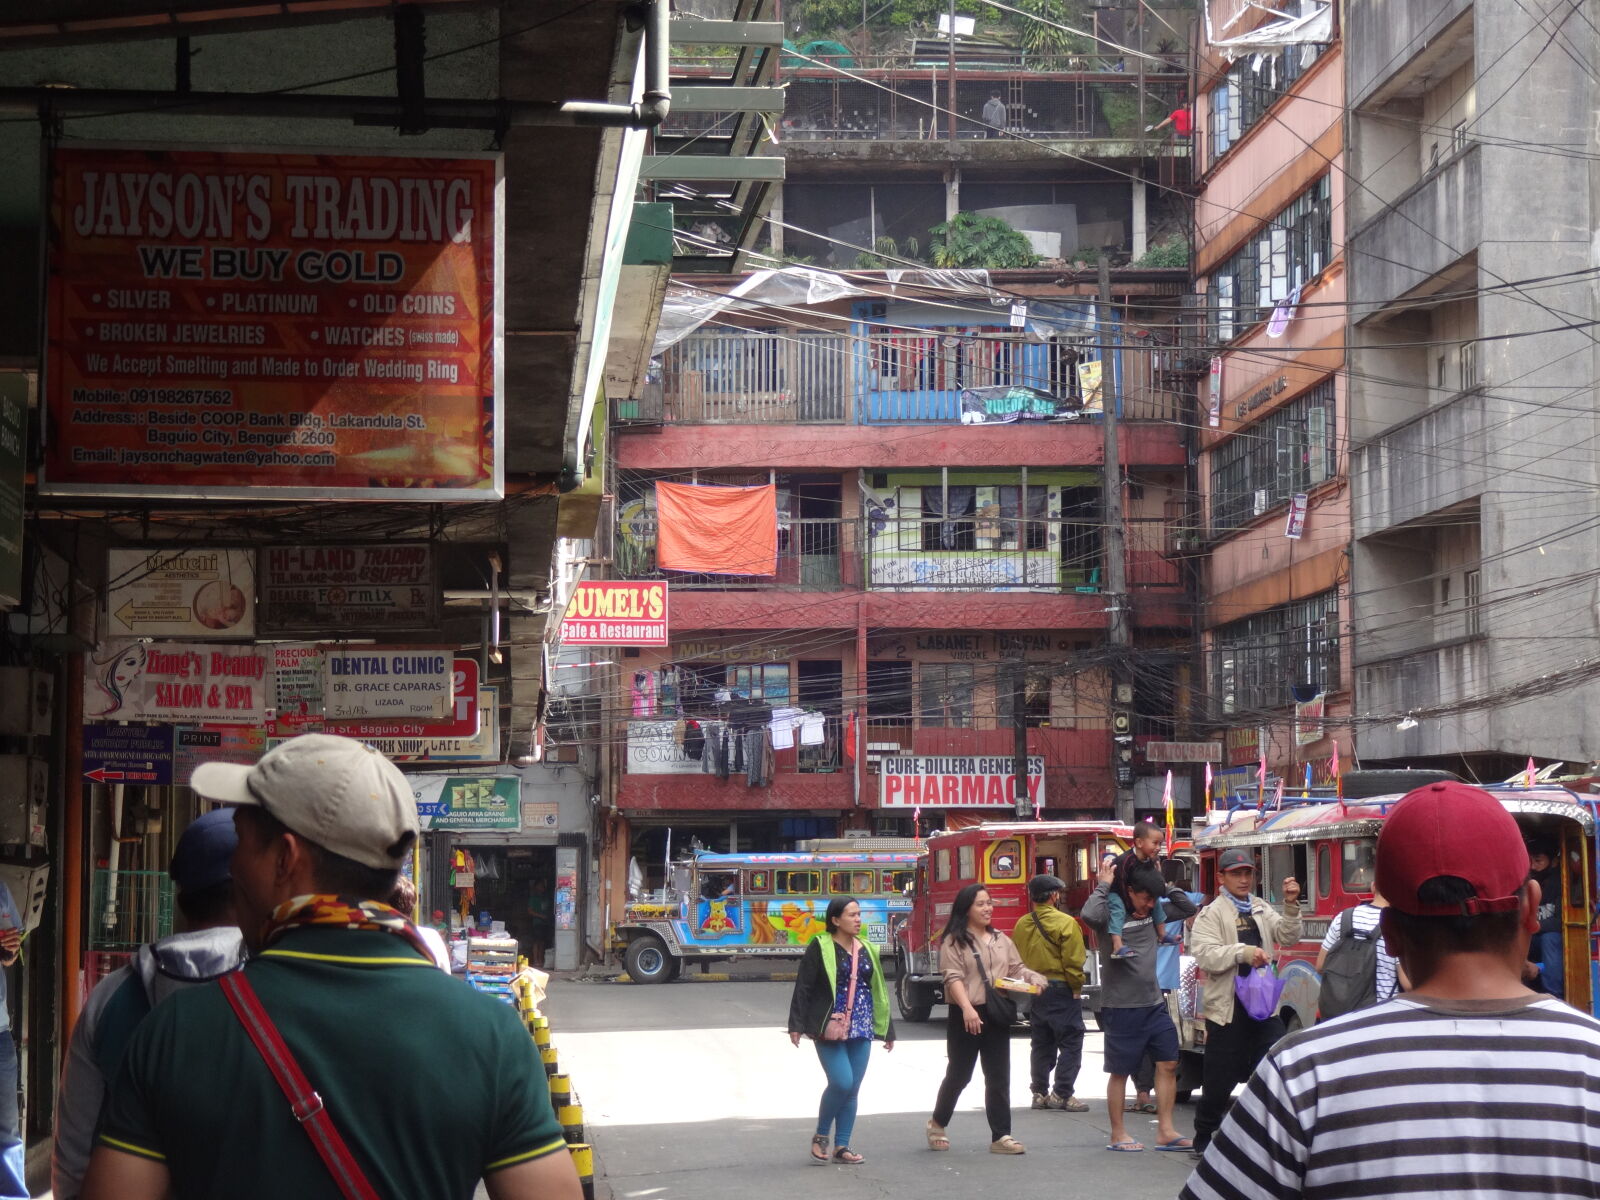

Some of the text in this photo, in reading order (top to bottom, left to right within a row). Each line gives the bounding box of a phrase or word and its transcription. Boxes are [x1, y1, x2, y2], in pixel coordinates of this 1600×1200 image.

[74, 172, 475, 244] JAYSON'S TRADING
[137, 245, 406, 284] WE BUY GOLD
[107, 289, 456, 315] SILVER PLATINUM OLD COINS
[100, 323, 167, 343] BROKEN
[172, 325, 265, 345] JEWELRIES
[325, 327, 404, 347] WATCHES
[87, 353, 458, 383] We Accept Smelting and Made to Order Wedding Ring
[73, 389, 232, 405] Mobile: 09198267562
[148, 411, 197, 425] Beside
[201, 412, 245, 426] COOP
[249, 412, 286, 427] Bank
[289, 413, 326, 431] Bldg.
[330, 414, 403, 429] Lakandula
[405, 415, 426, 429] St.
[148, 429, 335, 447] Baguio City, Benguet 2600
[73, 448, 335, 466] Email: jaysonchagwaten@yahoo.com
[270, 549, 356, 571] HI-LAND
[369, 566, 424, 583] SUPPLY
[561, 622, 665, 638] Cafe & Restaurant
[275, 648, 319, 658] PRECIOUS
[146, 650, 266, 681] Ziang's Beauty
[275, 659, 300, 668] PALM
[331, 656, 445, 675] DENTAL CLINIC
[333, 681, 446, 692] DR. GRACE CAPARAS-
[155, 683, 254, 710] SALON & SPA
[183, 734, 220, 743] PRINT
[360, 725, 400, 735] Baguio
[402, 725, 425, 736] City
[886, 758, 976, 775] CURE-DILLERA
[426, 805, 440, 814] ST.
